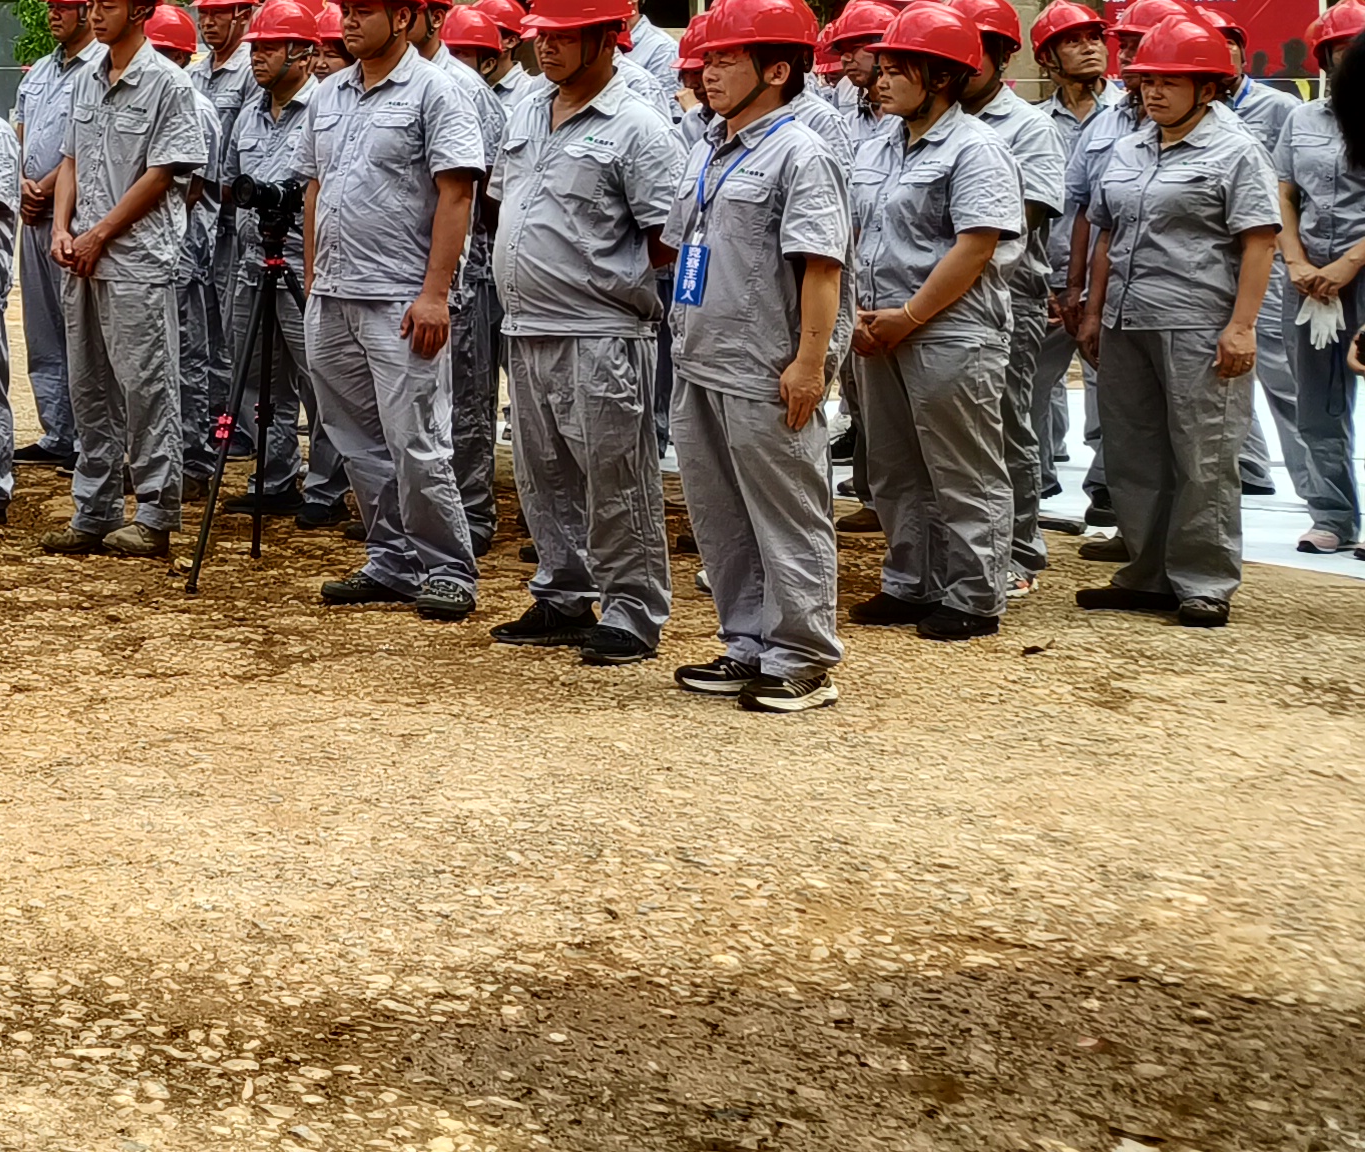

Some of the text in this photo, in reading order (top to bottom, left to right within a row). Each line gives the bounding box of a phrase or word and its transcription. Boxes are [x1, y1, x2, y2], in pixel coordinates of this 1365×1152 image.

[680, 246, 702, 302] 竞赛主持人
